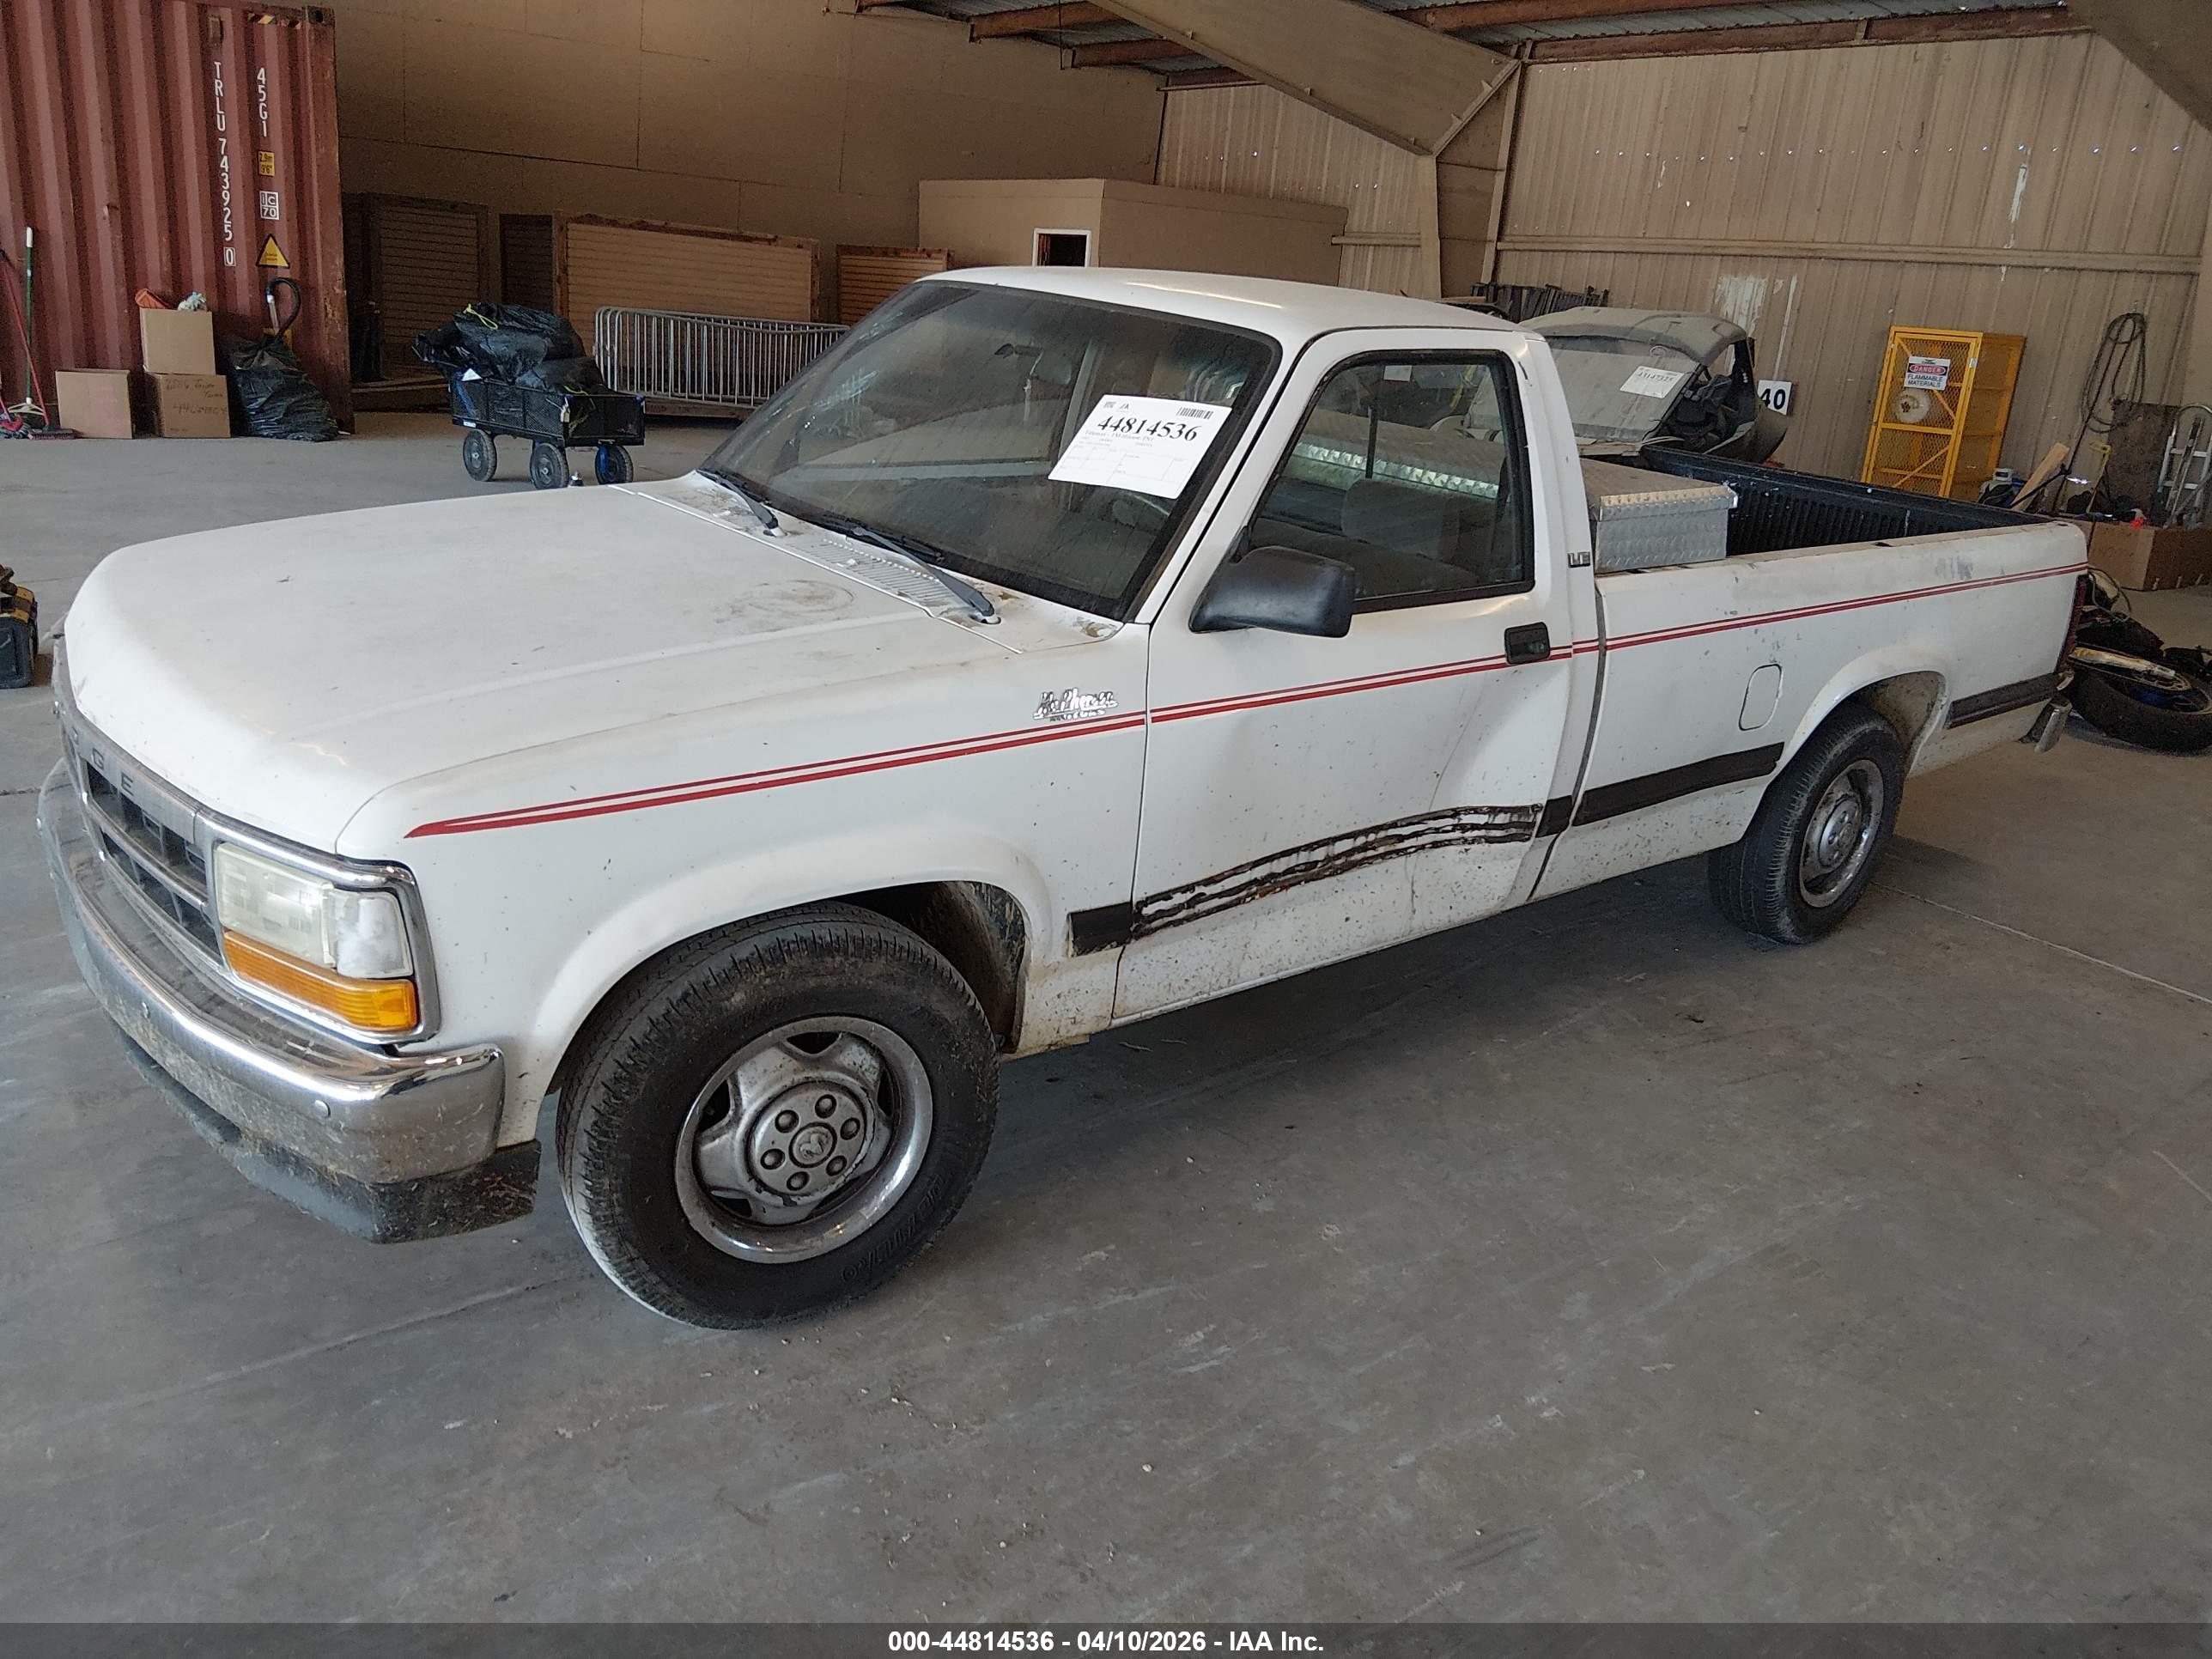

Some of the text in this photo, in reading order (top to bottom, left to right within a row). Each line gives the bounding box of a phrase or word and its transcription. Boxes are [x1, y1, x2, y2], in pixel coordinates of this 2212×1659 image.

[258, 67, 268, 137] 45G1
[214, 61, 234, 265] TRLU 743925 0
[262, 207, 276, 217] 70
[1913, 365, 1942, 374] DANGER
[1908, 374, 1943, 382] FLAMMABLE
[1908, 380, 1941, 388] MATERIALS
[1760, 388, 1786, 410] 40
[1097, 416, 1202, 441] 44814536
